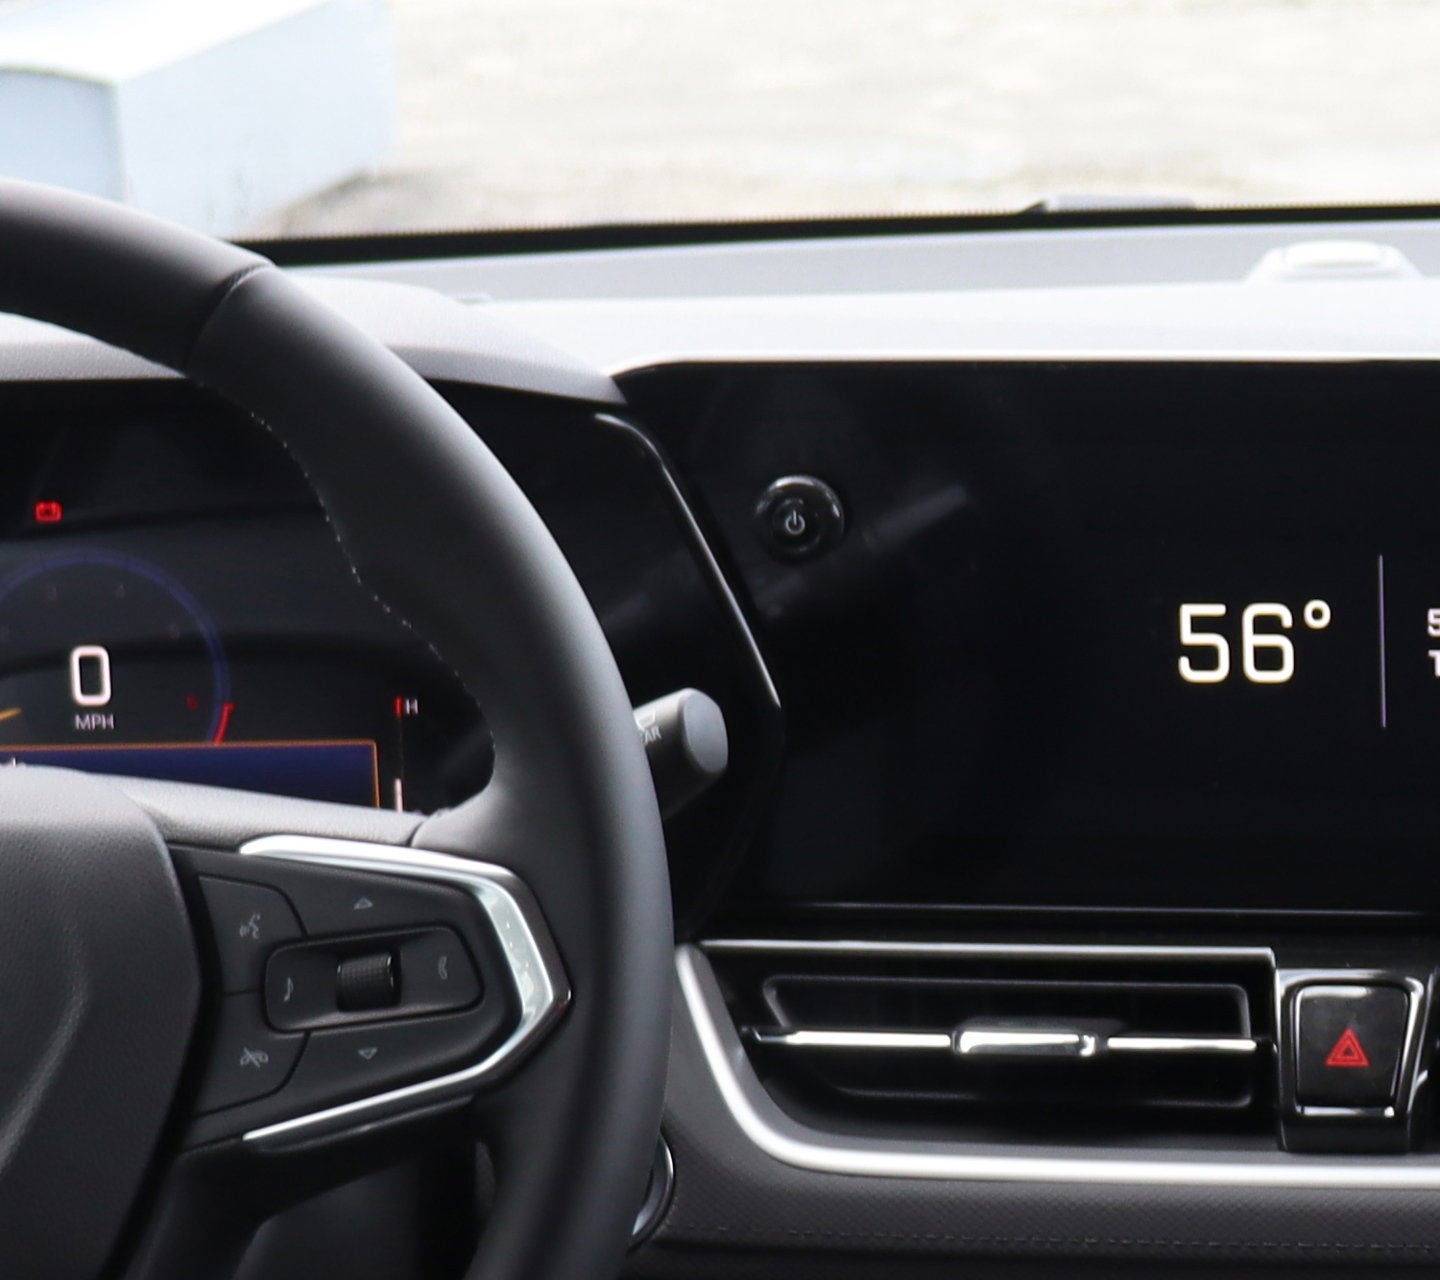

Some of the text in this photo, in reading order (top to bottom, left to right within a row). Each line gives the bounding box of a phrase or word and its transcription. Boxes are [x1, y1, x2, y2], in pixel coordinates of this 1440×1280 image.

[1177, 599, 1332, 684] 56°
[69, 645, 111, 706] 0
[74, 713, 115, 731] MPH
